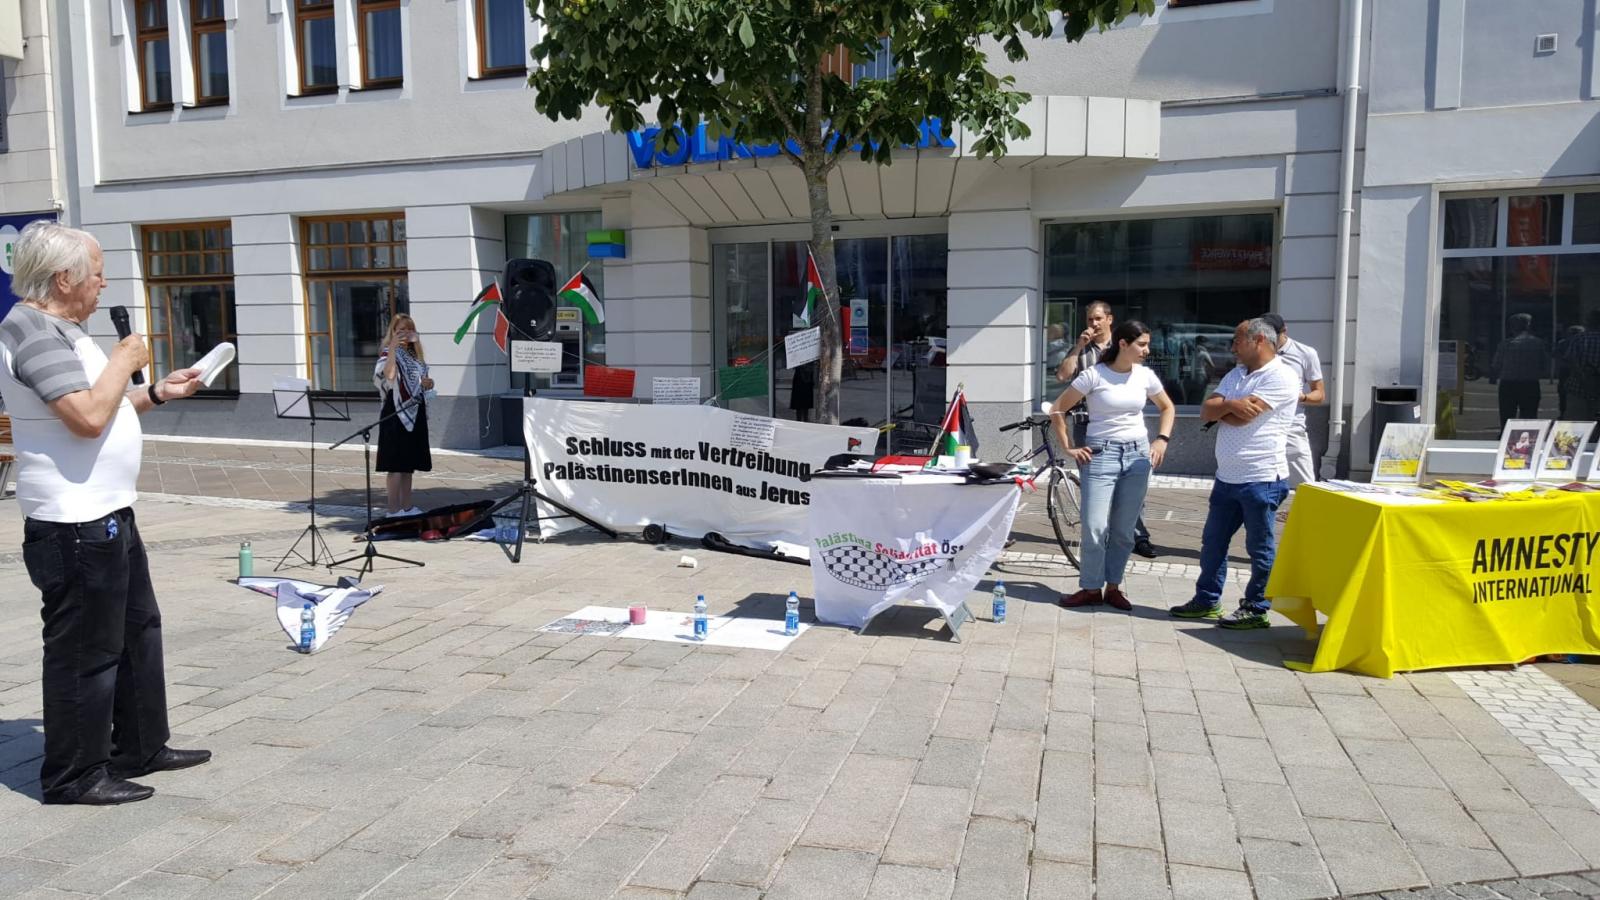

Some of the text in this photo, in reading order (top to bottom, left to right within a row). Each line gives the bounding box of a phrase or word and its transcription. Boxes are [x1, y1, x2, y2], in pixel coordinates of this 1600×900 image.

[566, 436, 812, 481] Schluss mit der Vertreibung
[543, 461, 811, 505] PalästinenserInnen aus Jerus
[1472, 531, 1600, 574] AMNESTY
